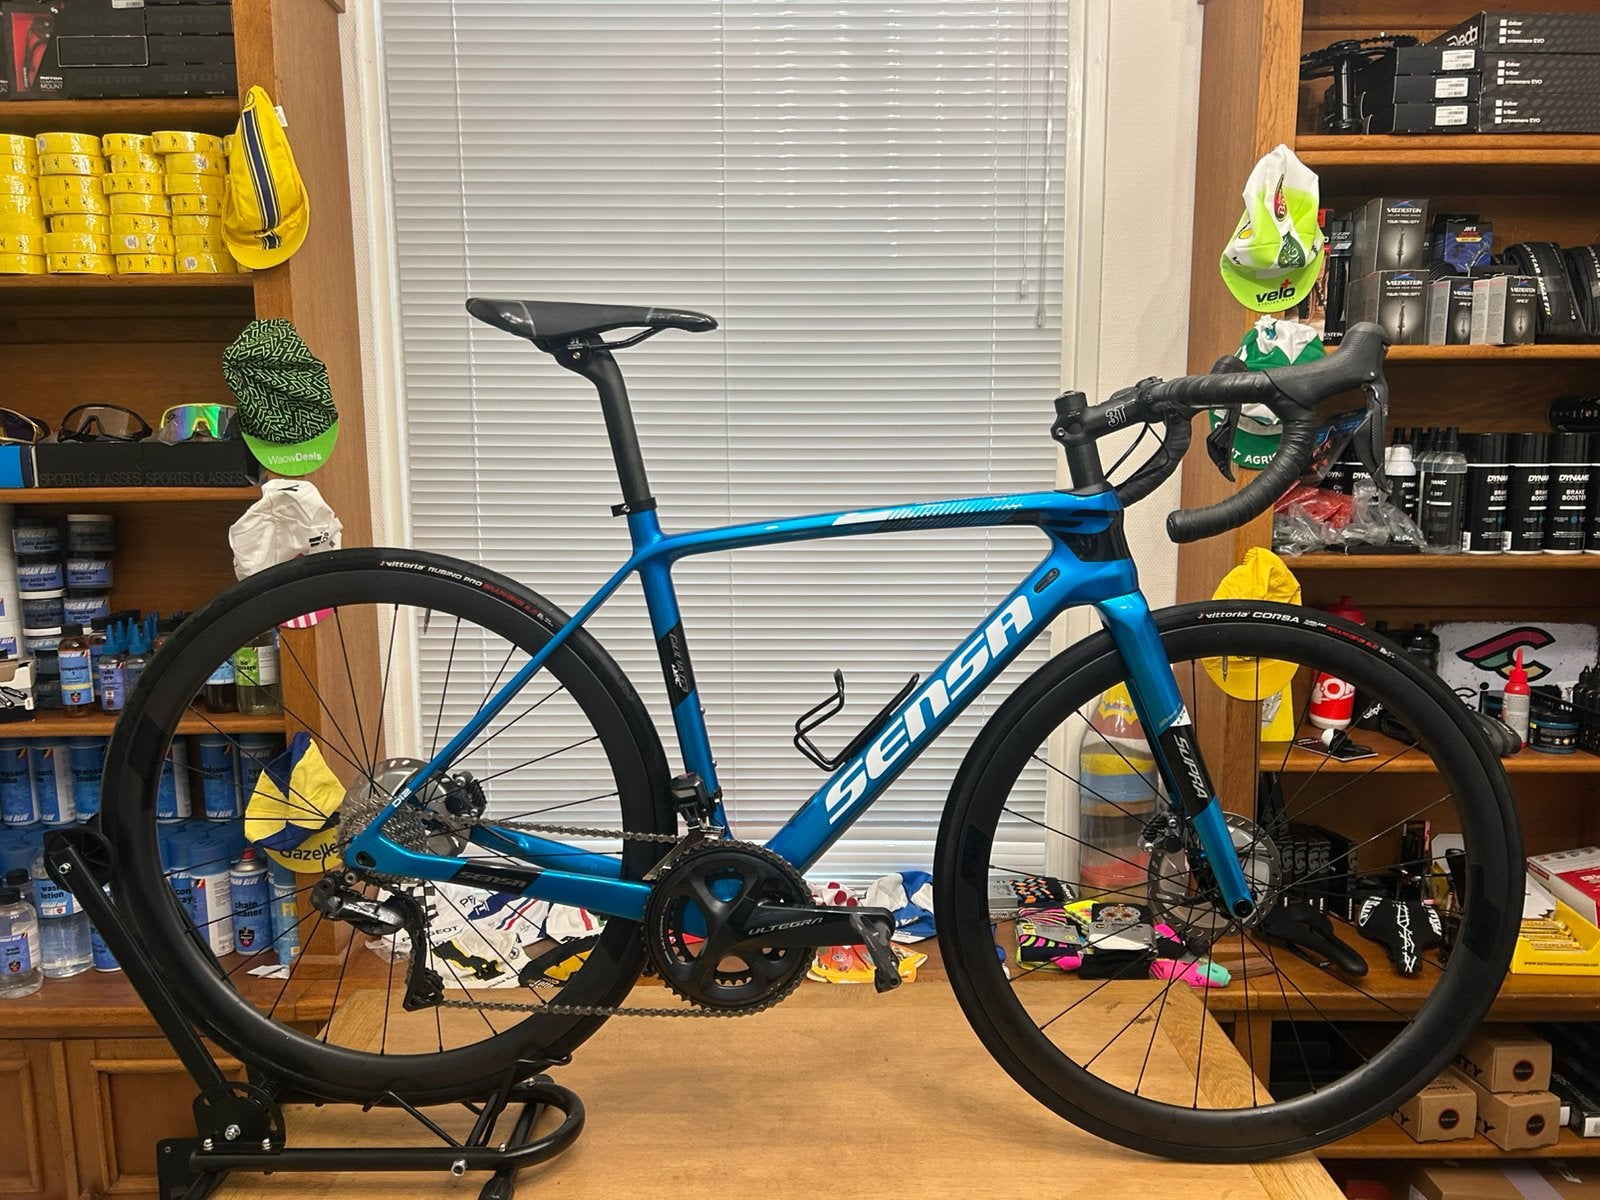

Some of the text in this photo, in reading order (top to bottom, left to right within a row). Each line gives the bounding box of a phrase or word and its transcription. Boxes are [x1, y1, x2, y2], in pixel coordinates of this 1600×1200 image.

[1105, 404, 1126, 427] 3T
[40, 471, 143, 485] SPORTS GLASSES
[146, 472, 245, 485] SPORTS GLASSES
[427, 566, 463, 580] RUBINO
[463, 576, 483, 587] PRO
[1206, 611, 1249, 619] vittoria
[1252, 611, 1300, 624] CORSA
[1173, 734, 1208, 799] SUPRA
[41, 891, 64, 900] lotion
[748, 916, 823, 936] ULTEGRA
